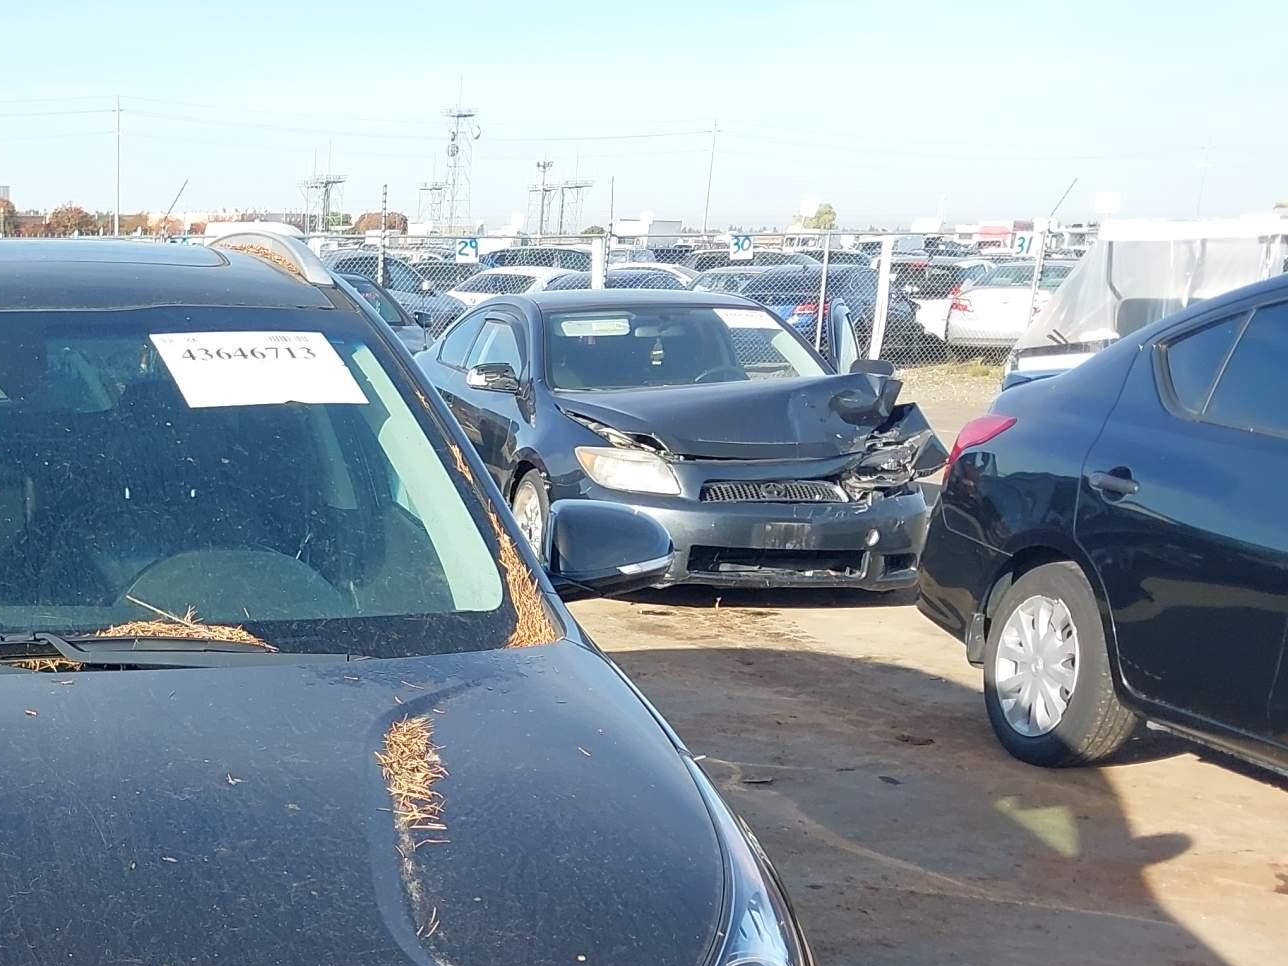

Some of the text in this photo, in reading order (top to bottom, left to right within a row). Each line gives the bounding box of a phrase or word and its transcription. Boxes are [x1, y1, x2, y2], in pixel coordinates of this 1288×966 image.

[458, 239, 479, 258] 29
[732, 235, 752, 254] 30
[1015, 236, 1033, 255] 31
[181, 347, 317, 361] 43646713
